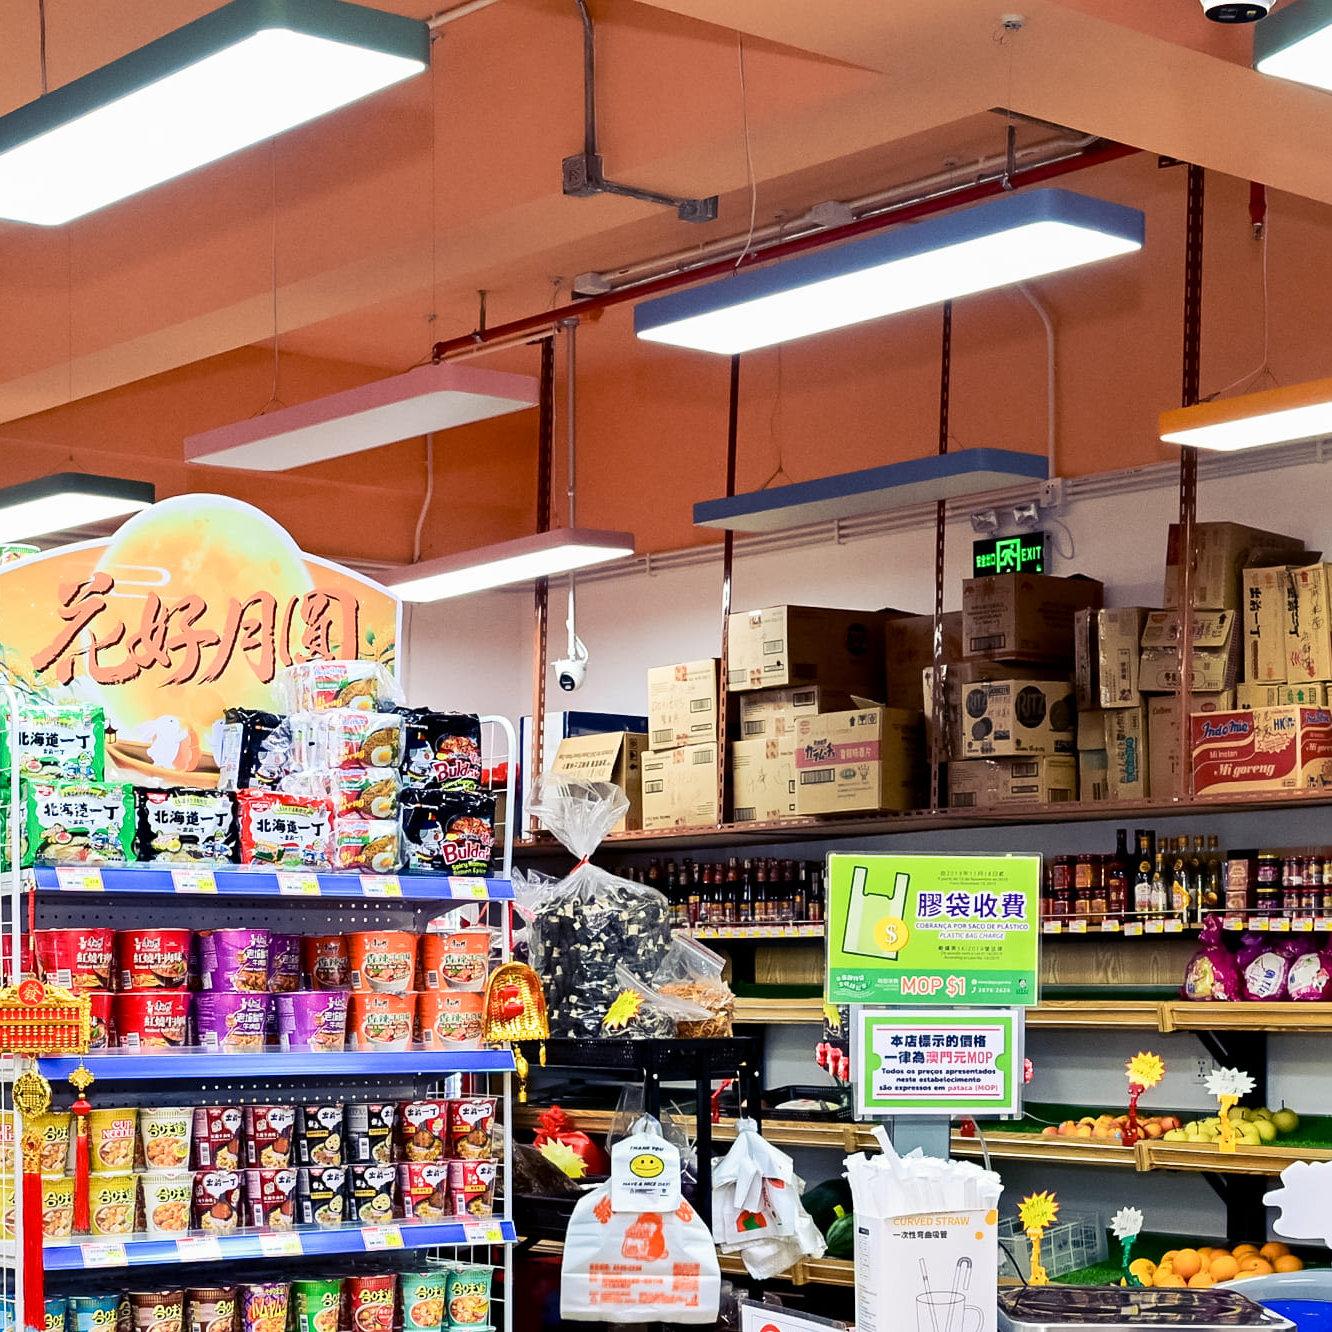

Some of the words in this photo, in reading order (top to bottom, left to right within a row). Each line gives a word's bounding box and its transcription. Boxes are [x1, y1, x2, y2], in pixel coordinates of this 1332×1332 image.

[1021, 546, 1042, 562] EXIT
[1249, 587, 1262, 638] 出前一丁
[1214, 764, 1233, 776] Mi
[1234, 764, 1275, 777] goreng
[44, 803, 120, 820] 北海道一丁
[154, 810, 228, 827] 北海道一丁
[256, 818, 324, 835] 北海道一丁
[918, 893, 1024, 918] 膠袋收費
[997, 922, 1028, 930] PLÁSTICO
[133, 952, 183, 963] 紅燒牛肉味
[902, 977, 943, 995] MOP
[947, 975, 966, 997] $1
[25, 986, 41, 1002] 發
[890, 1035, 987, 1048] 本店標示的價格
[884, 1051, 993, 1065] 一律為澳門元MOP
[918, 1068, 943, 1076] preços
[975, 1084, 998, 1092] (MOP)
[112, 1120, 133, 1130] CUP
[148, 1121, 186, 1137] 合味道
[893, 1216, 932, 1227] CURVED
[935, 1216, 970, 1227] STRAW
[452, 1281, 486, 1296] 合味道
